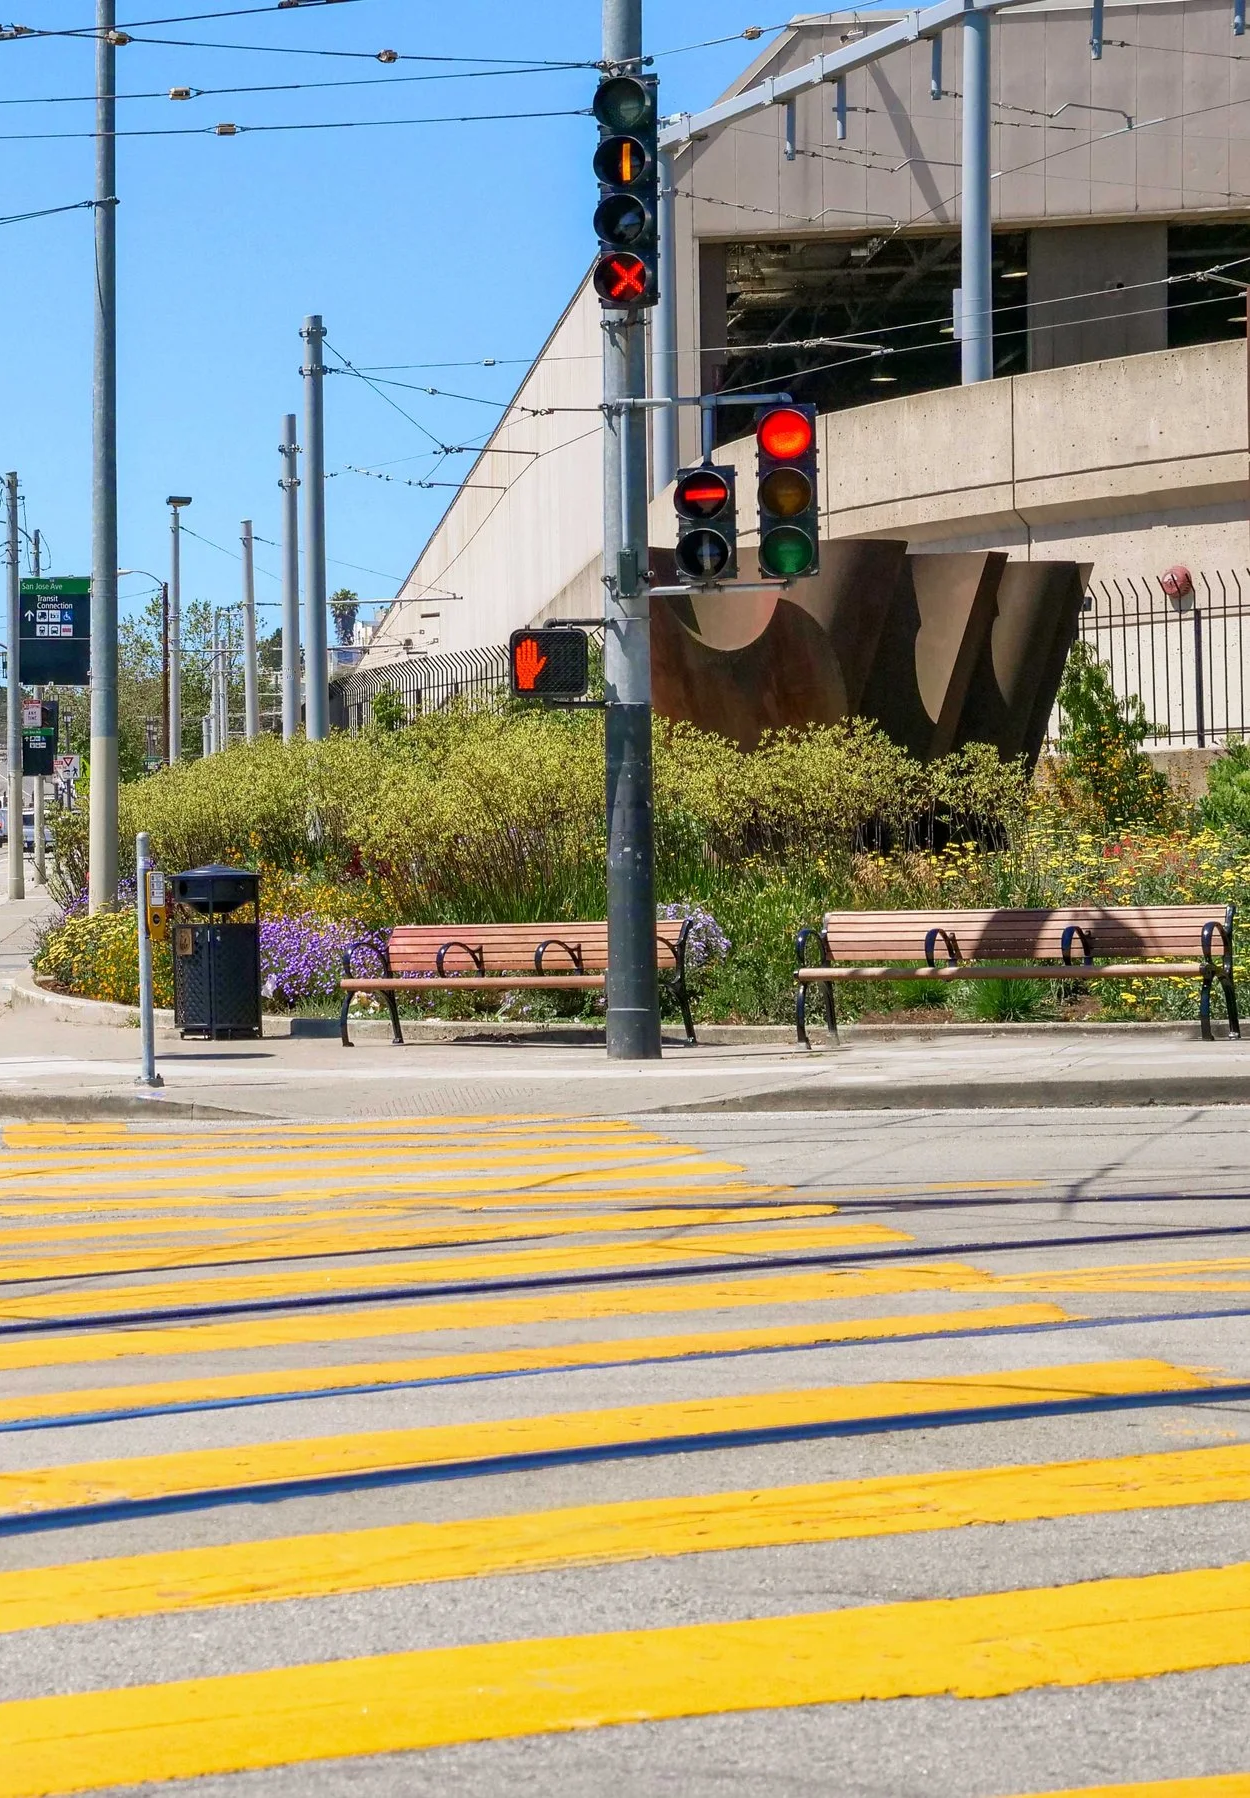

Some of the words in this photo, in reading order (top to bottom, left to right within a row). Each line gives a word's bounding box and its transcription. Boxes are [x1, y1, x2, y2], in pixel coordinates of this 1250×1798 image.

[21, 582, 34, 590] San
[35, 582, 50, 590] Jose
[50, 582, 63, 590] Ave
[36, 594, 58, 602] Transit
[36, 601, 73, 609] Connection
